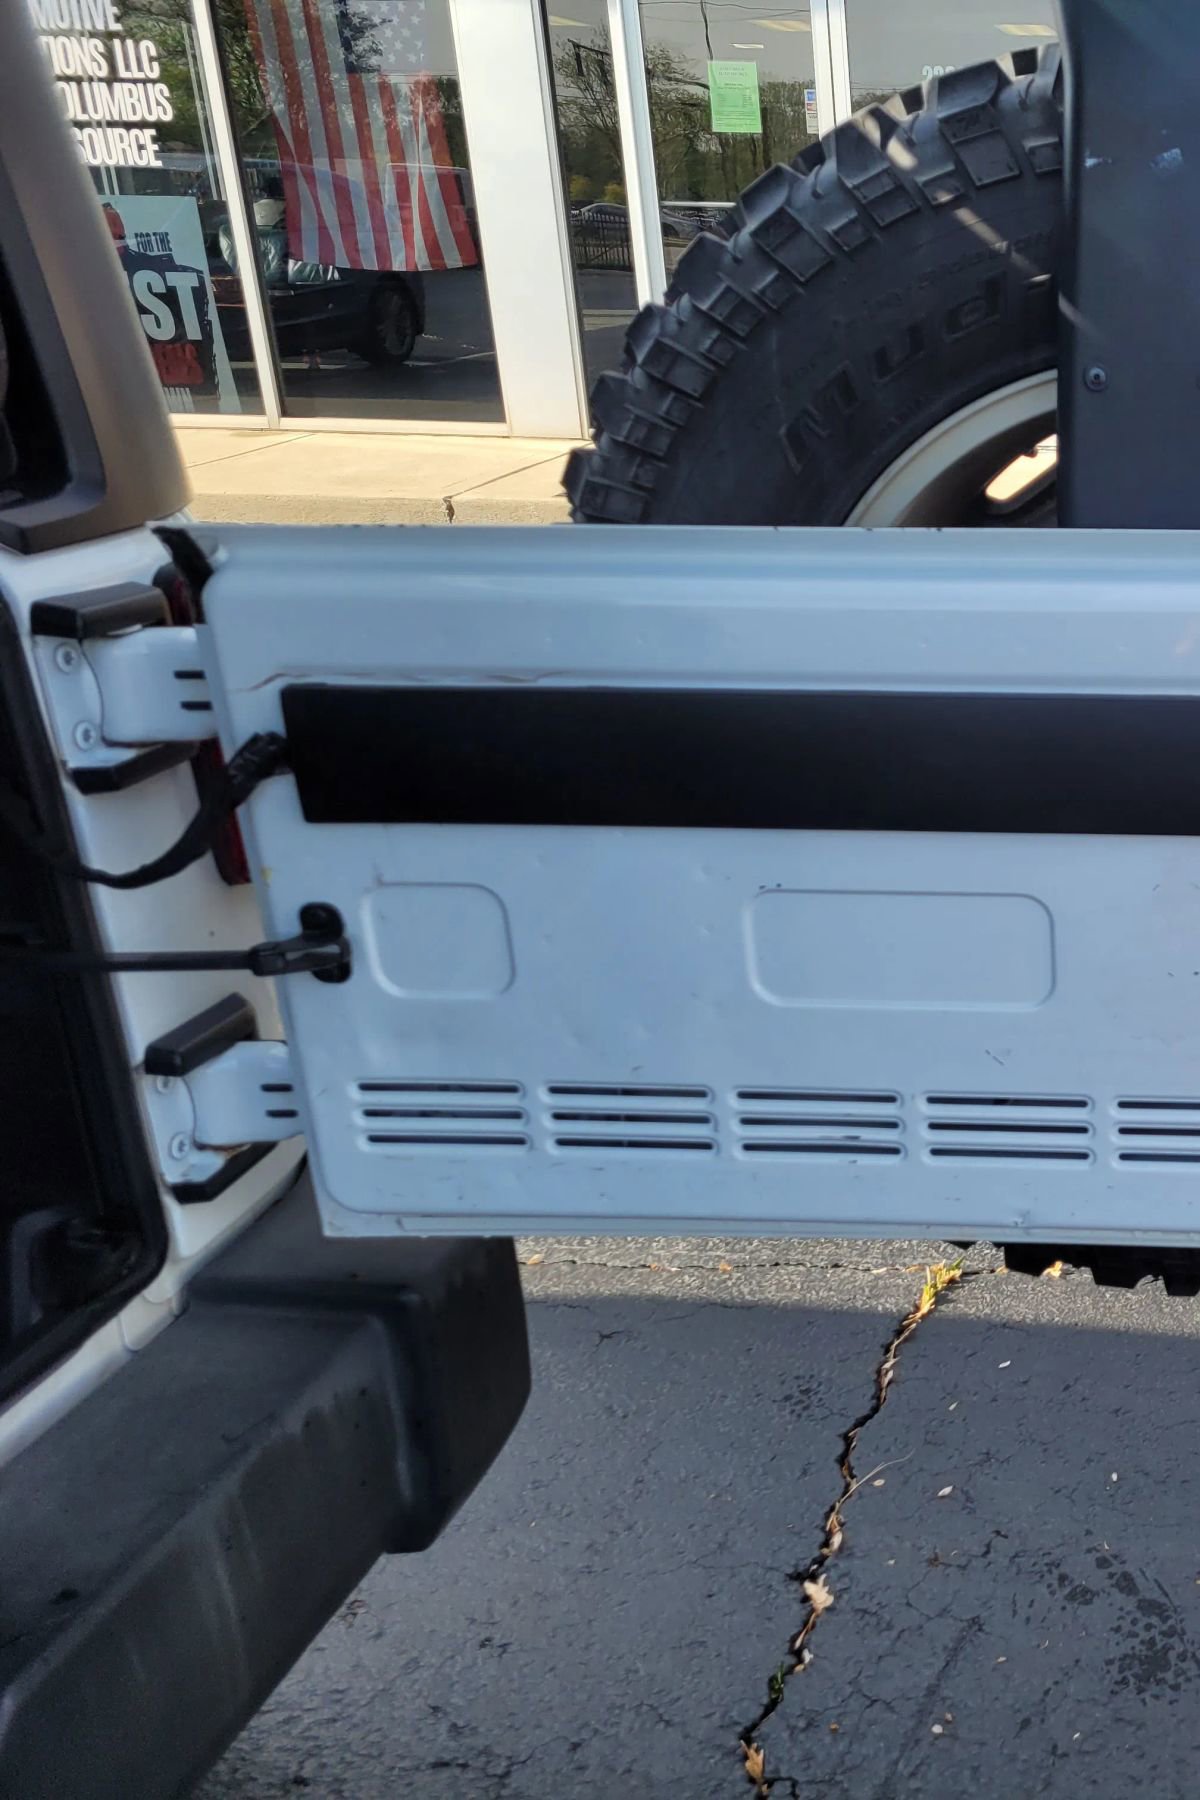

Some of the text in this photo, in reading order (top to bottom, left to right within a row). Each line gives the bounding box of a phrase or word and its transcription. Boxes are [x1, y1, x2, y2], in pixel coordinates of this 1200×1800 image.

[112, 38, 160, 79] LLC
[134, 231, 173, 253] FOR THE
